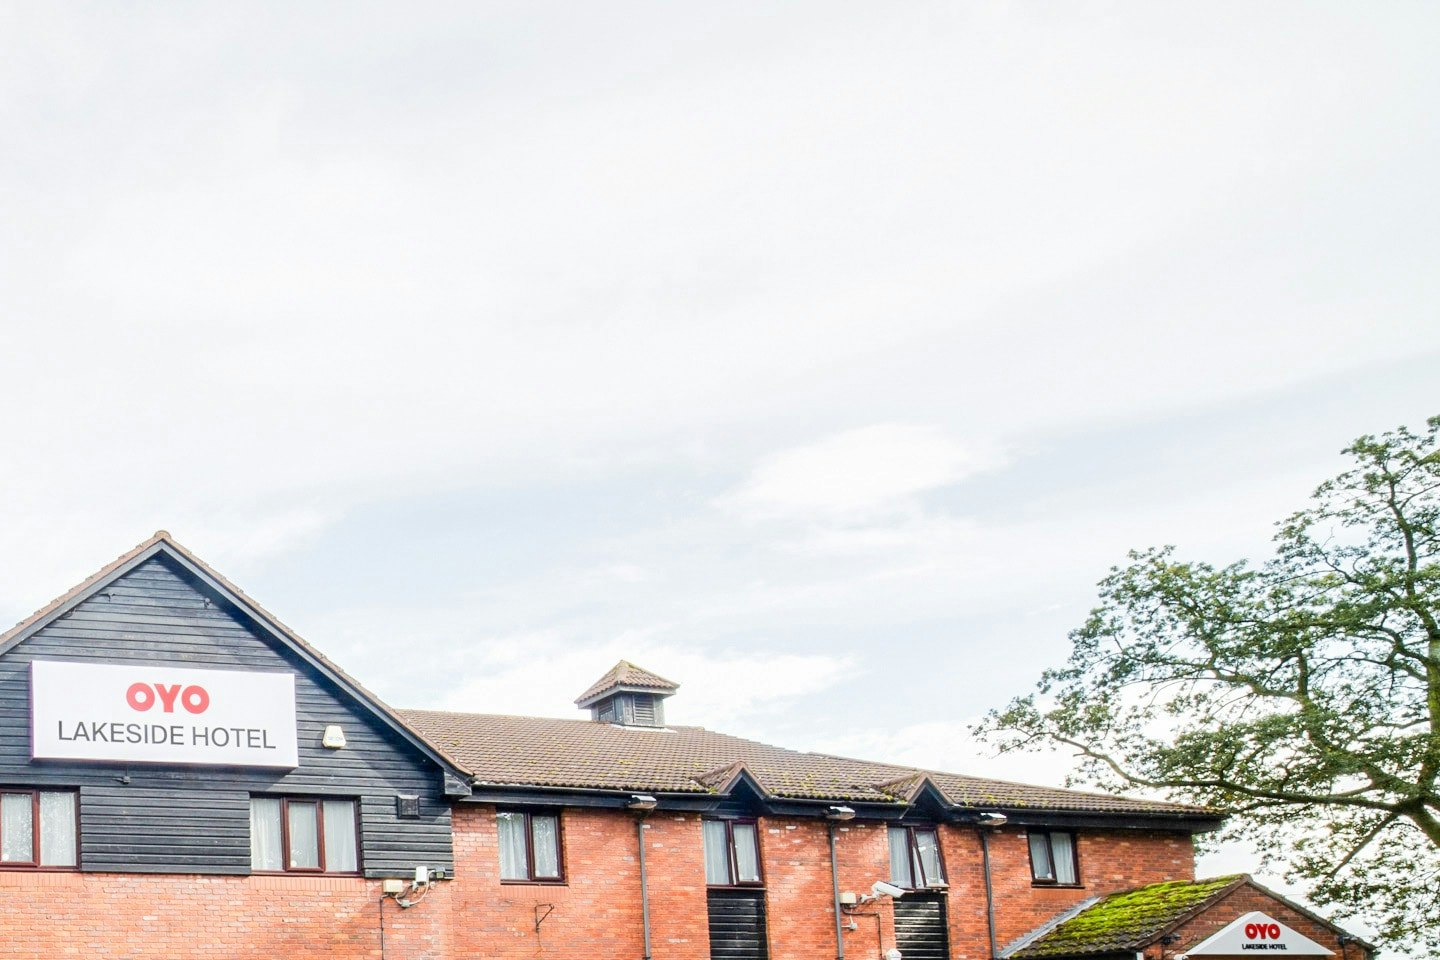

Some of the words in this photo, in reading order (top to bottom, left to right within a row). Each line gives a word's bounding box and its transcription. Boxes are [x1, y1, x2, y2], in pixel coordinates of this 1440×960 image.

[126, 682, 210, 715] OYO
[58, 720, 185, 746] LAKESIDE
[192, 726, 277, 749] HOTEL
[1245, 923, 1281, 940] OYO
